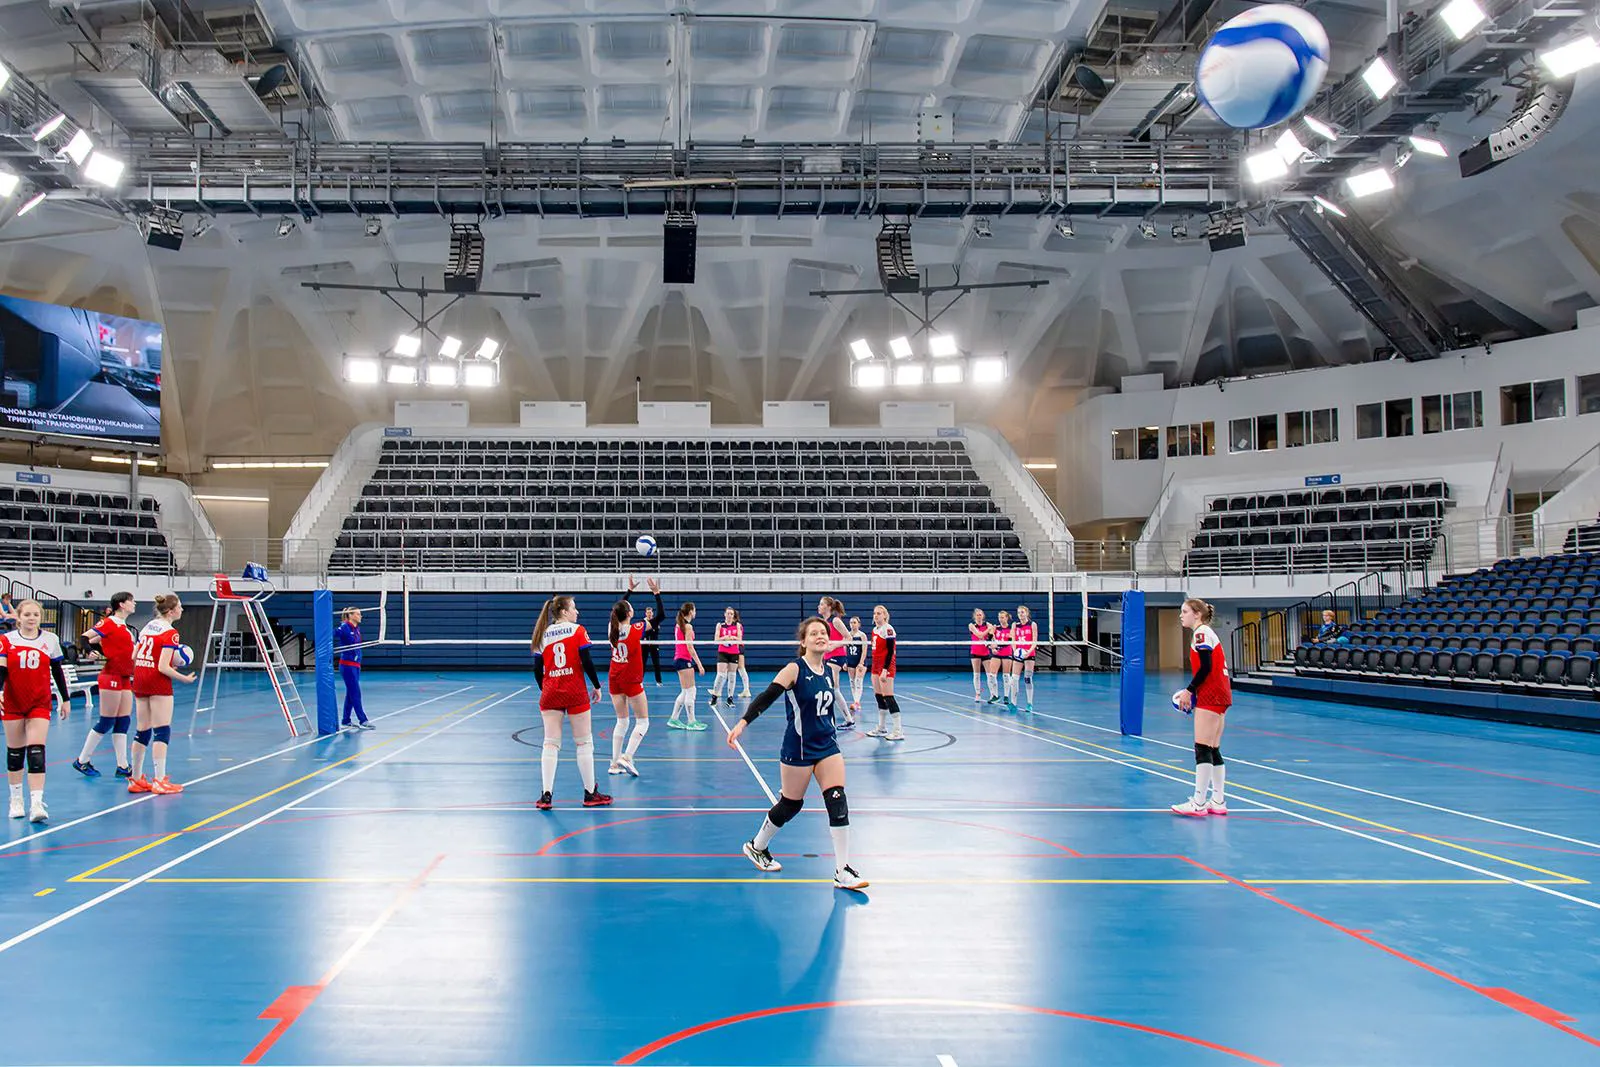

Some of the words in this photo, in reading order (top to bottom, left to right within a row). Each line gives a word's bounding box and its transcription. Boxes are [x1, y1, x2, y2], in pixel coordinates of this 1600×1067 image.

[27, 410, 47, 419] ЗАЛЕ
[47, 412, 97, 424] УСТАНОВИЛИ
[97, 419, 144, 430] УНИКАЛЬНЫЕ
[136, 635, 154, 660] 22
[553, 642, 567, 669] 8
[849, 645, 858, 656] 12
[17, 649, 40, 670] 18
[815, 690, 834, 717] 12
